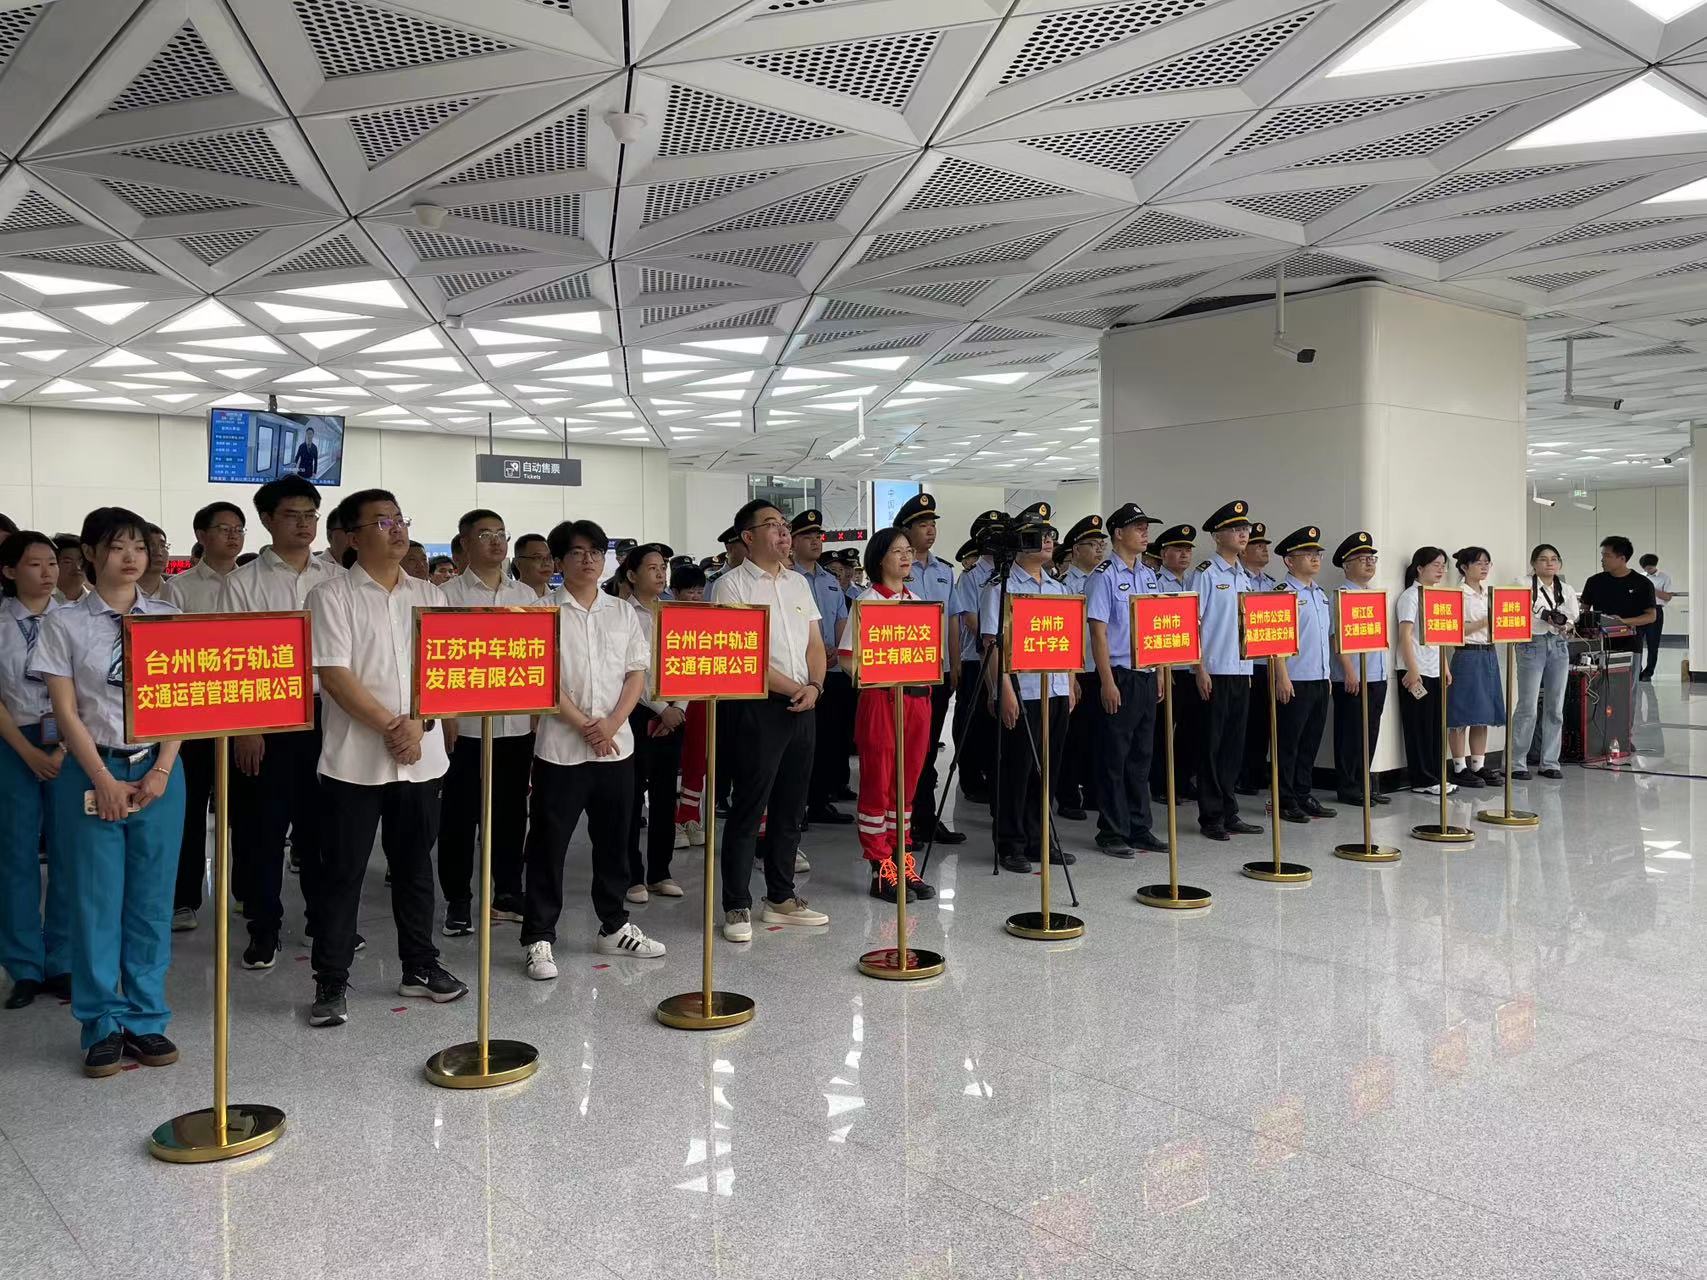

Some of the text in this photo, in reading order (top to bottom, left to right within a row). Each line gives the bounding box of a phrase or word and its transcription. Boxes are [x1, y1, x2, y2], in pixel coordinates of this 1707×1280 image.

[523, 461, 561, 474] 自动售票
[1030, 615, 1064, 632] 台州市
[1152, 614, 1181, 630] 台州市
[1250, 609, 1291, 625] 台州市公安局
[1427, 619, 1459, 632] 交通运输局
[1496, 616, 1527, 628] 交通运输局
[868, 624, 931, 643] 台州市公交
[1344, 622, 1382, 637] 交通运输局
[426, 637, 546, 661] 江苏中车城市
[665, 630, 758, 650] 台州台中轨道
[1023, 635, 1070, 653] 红十字会
[1144, 632, 1191, 649] 交通运输局
[145, 643, 296, 676] 台州畅行轨道
[665, 655, 758, 676] 交通有限公司
[862, 646, 937, 667] 巴士有限公司
[425, 664, 546, 690] 发展有限公司
[137, 675, 304, 711] 交通运营管理有限公司
